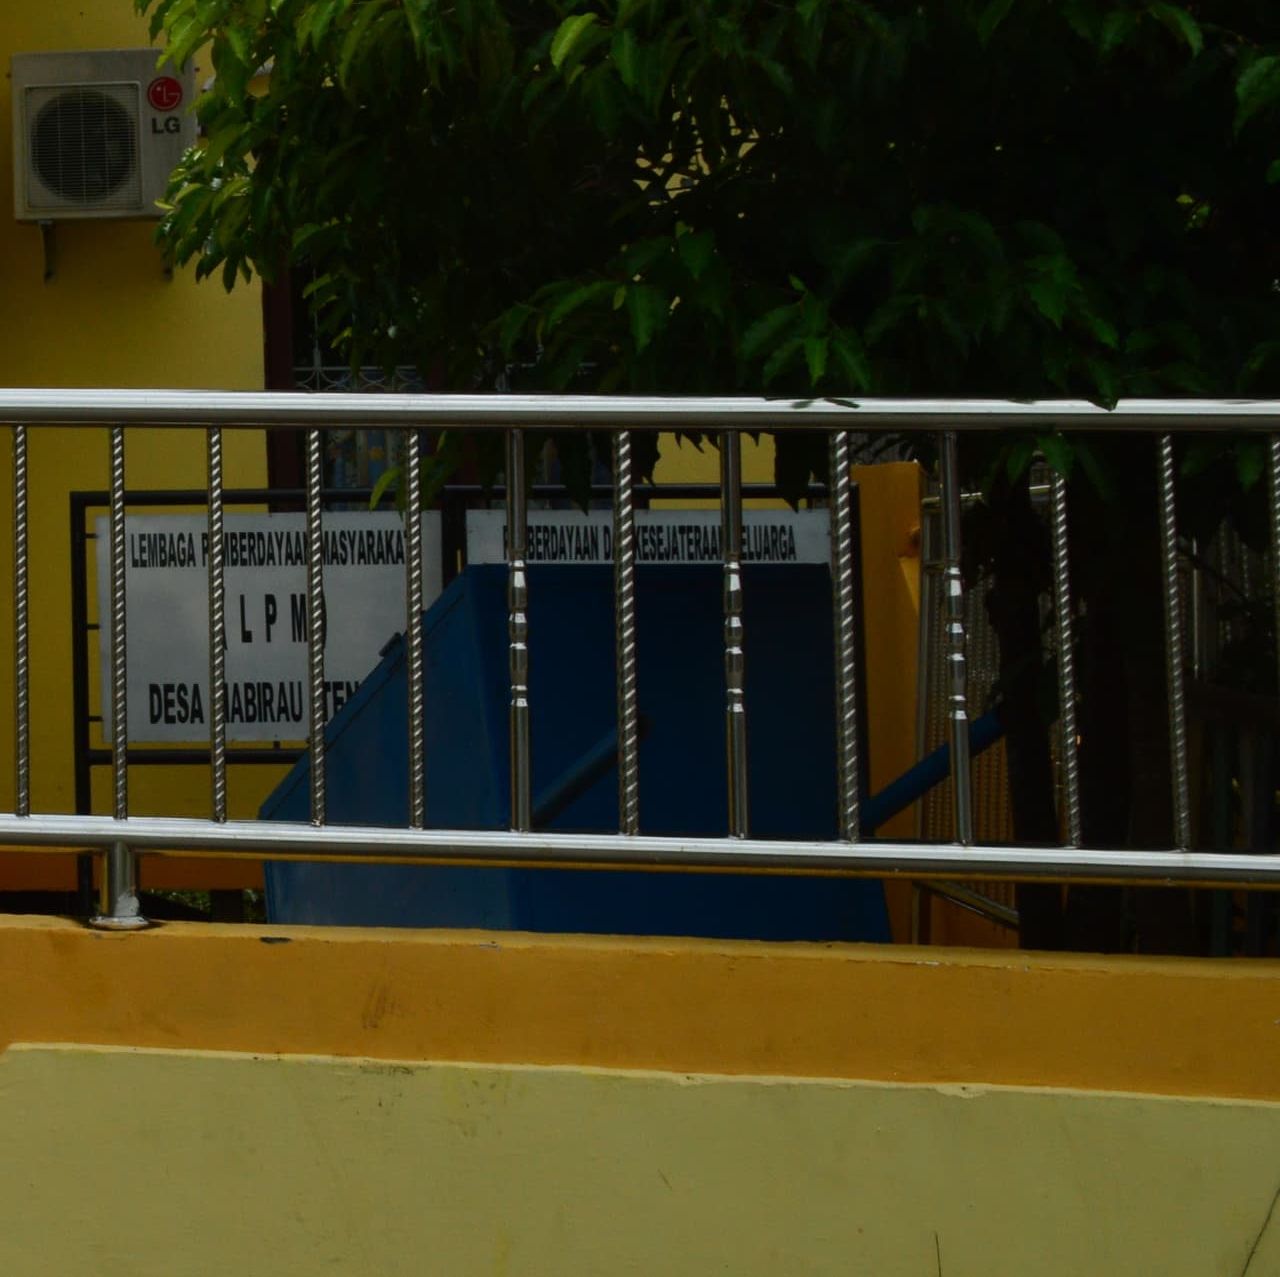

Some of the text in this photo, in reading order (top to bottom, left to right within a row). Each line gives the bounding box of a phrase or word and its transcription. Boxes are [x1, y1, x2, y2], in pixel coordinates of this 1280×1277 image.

[151, 117, 181, 135] LG
[130, 533, 197, 568] LEMBAGA
[739, 525, 798, 561] ELUARGA
[149, 683, 205, 724] DESA
